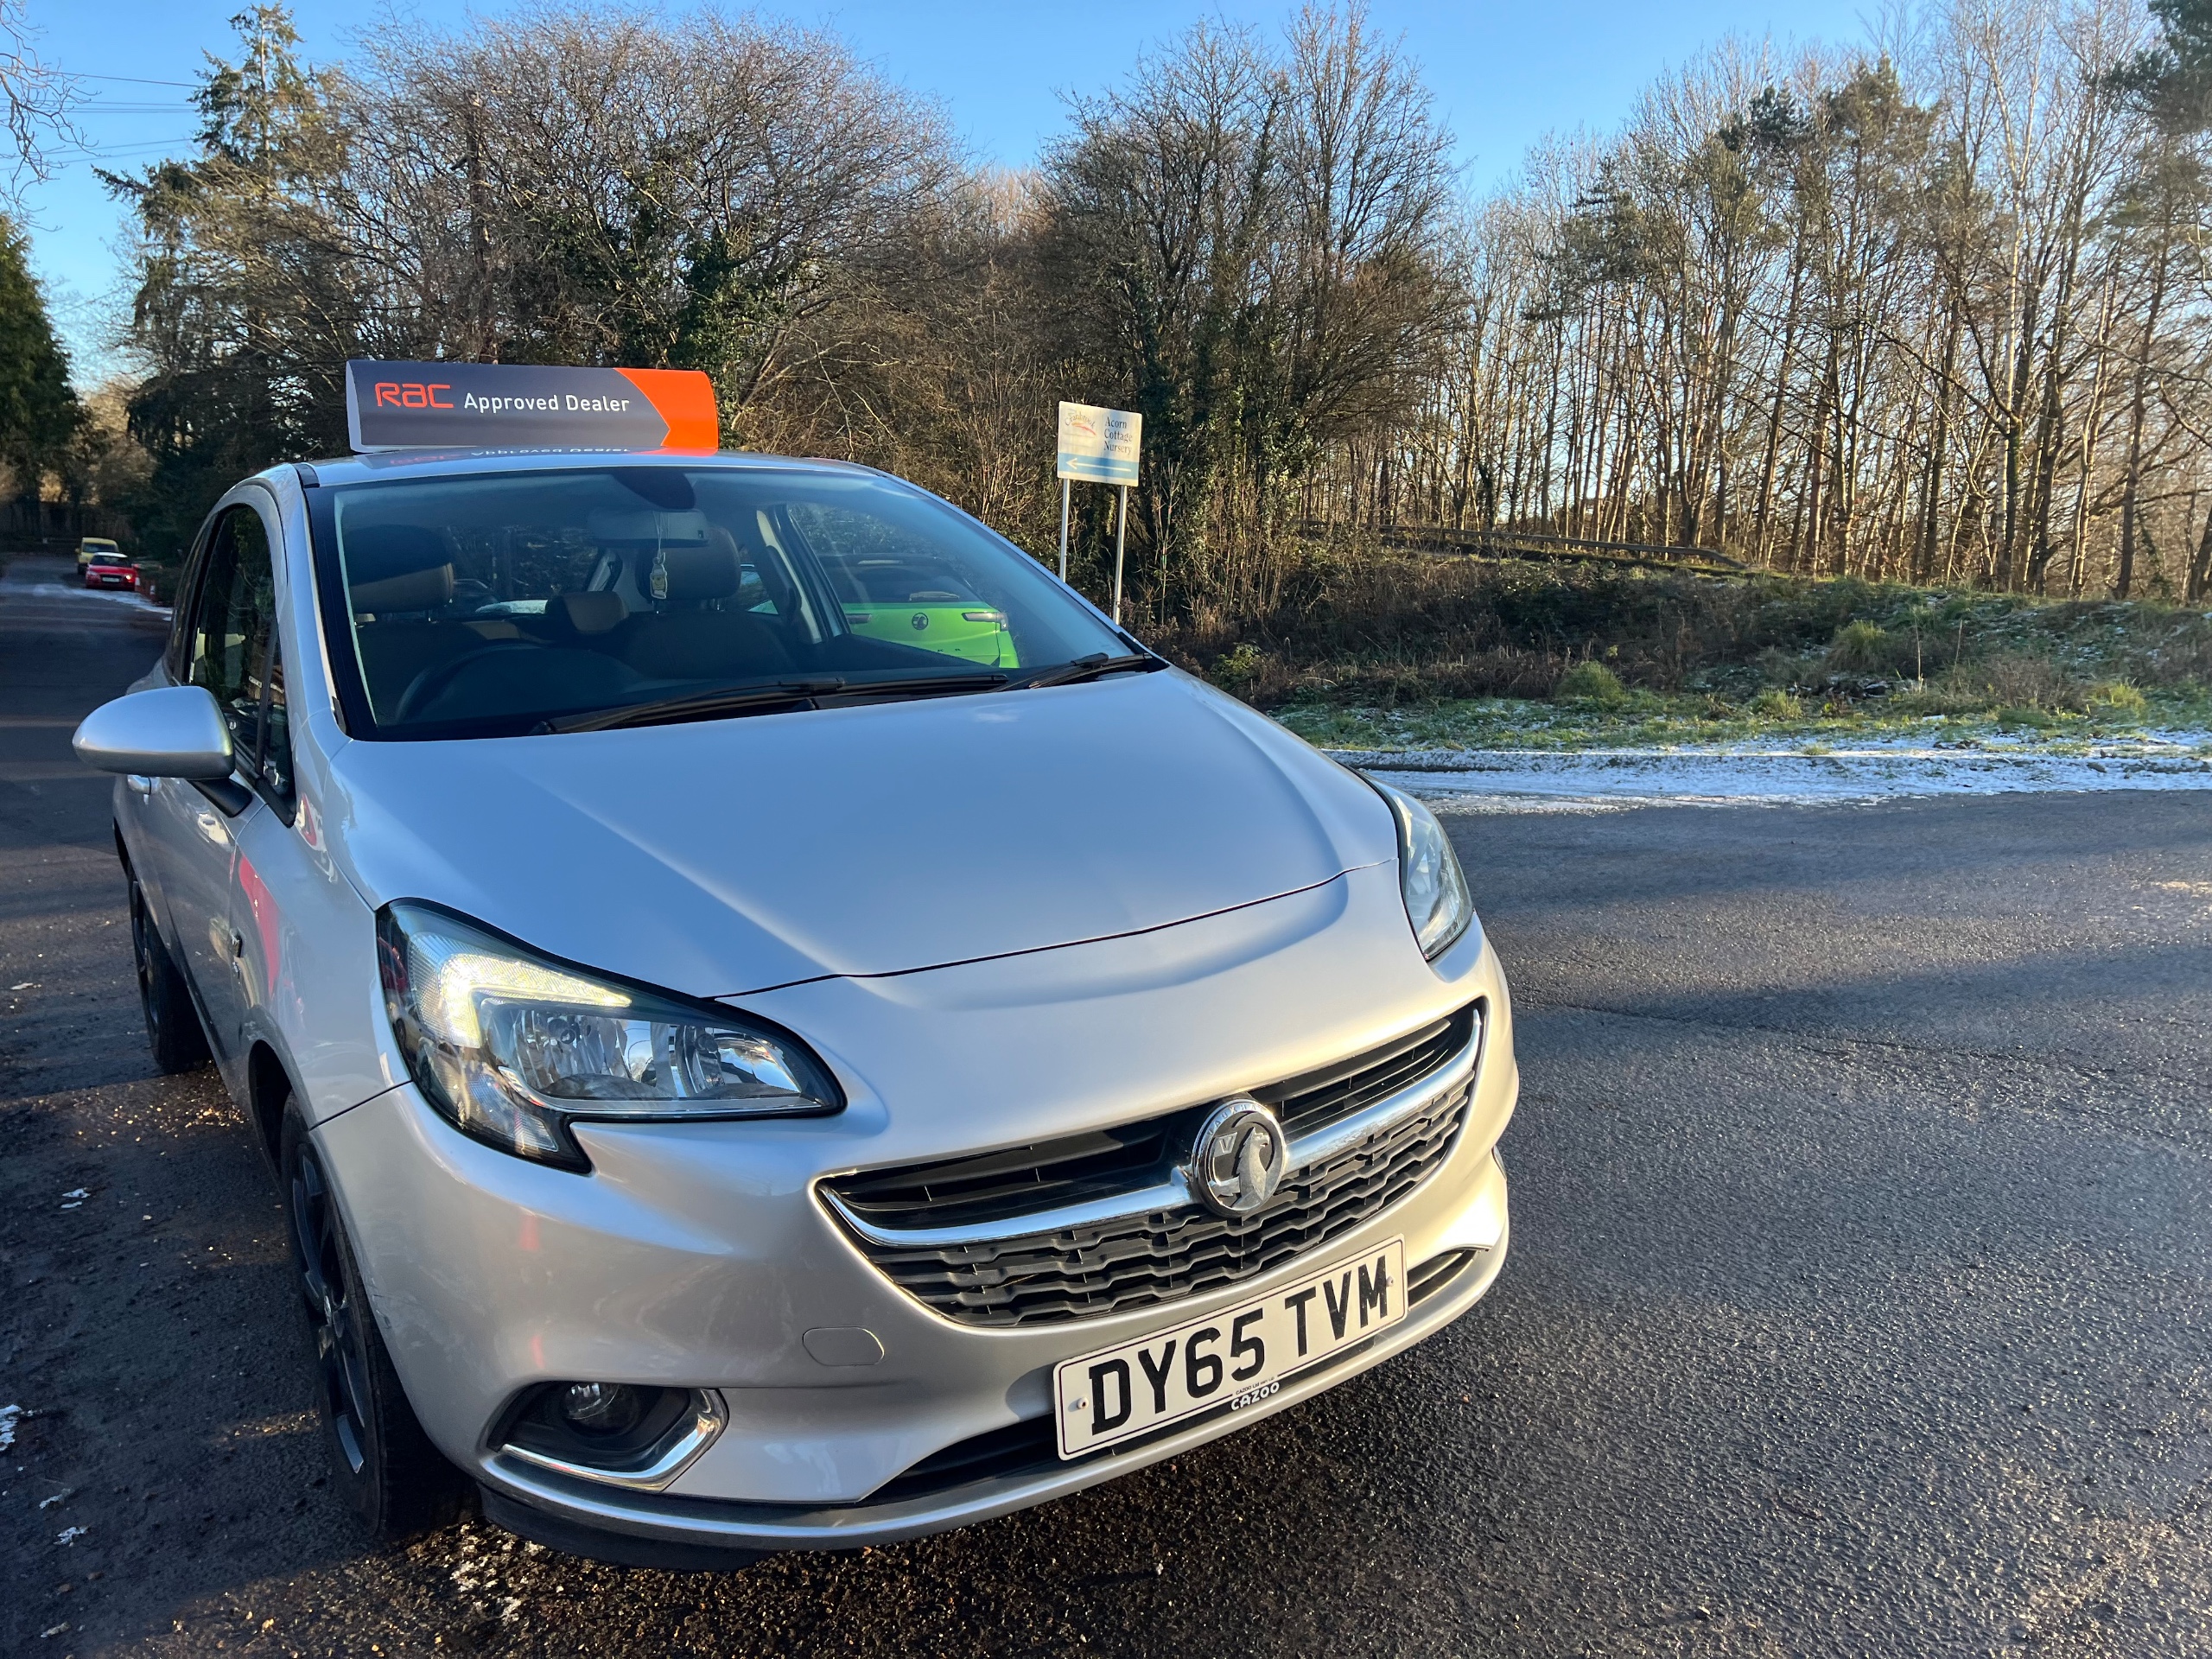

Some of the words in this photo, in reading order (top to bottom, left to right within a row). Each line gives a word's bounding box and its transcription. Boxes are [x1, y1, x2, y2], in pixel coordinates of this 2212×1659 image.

[463, 392, 559, 414] Approved
[566, 395, 630, 412] Dealer
[1104, 416, 1128, 429] Acorn
[1104, 429, 1133, 442] Cottage
[1103, 441, 1132, 455] Nursery
[1207, 1103, 1269, 1135] VAUXHA
[1088, 1307, 1265, 1436] DY65
[1284, 1255, 1388, 1357] TVM
[1230, 1382, 1280, 1411] CAZOO
